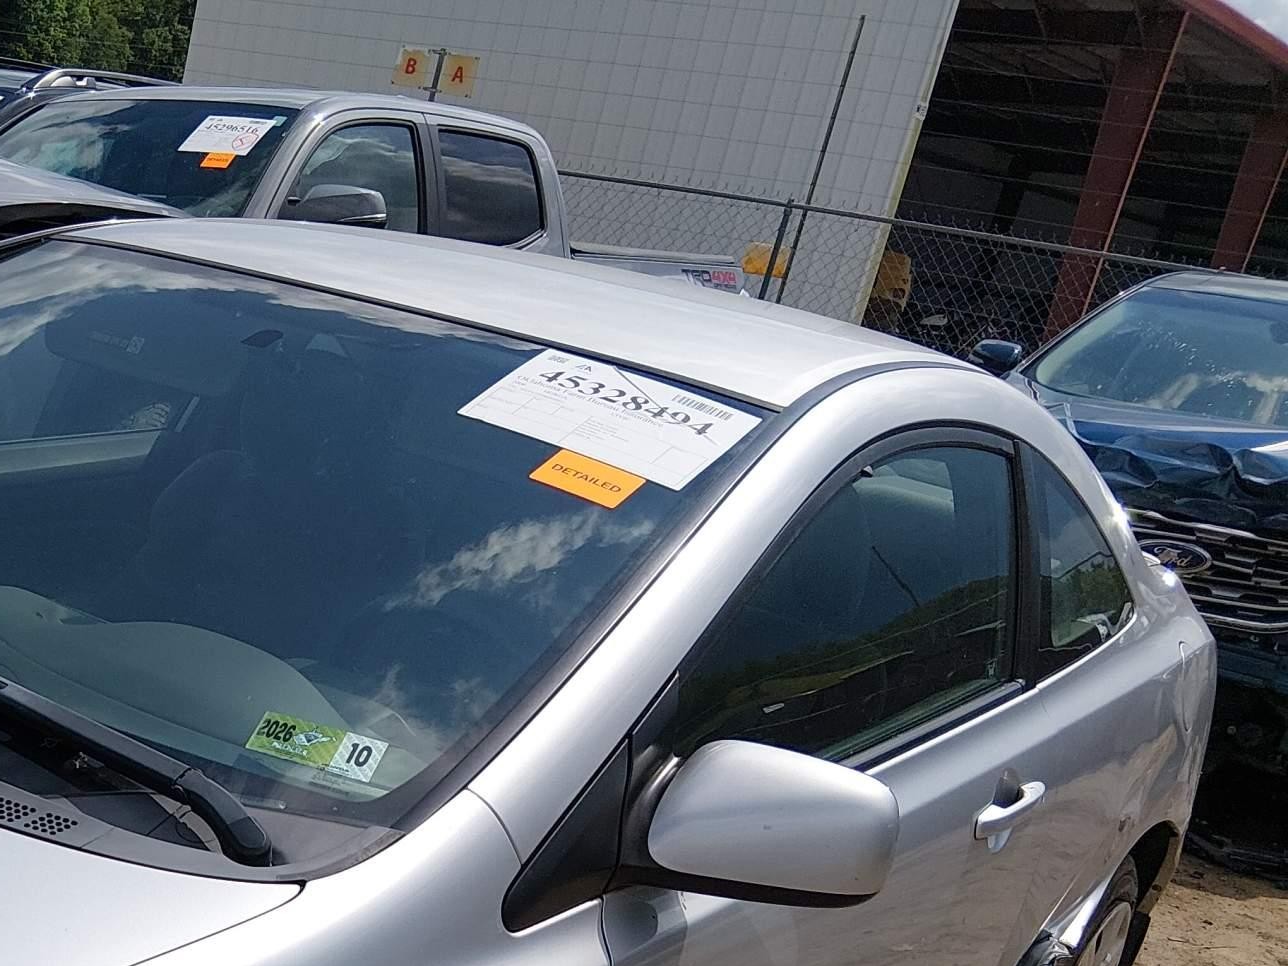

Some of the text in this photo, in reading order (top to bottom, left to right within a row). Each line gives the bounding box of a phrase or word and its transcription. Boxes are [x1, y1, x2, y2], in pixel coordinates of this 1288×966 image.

[404, 57, 417, 74] B
[451, 65, 464, 83] A
[539, 371, 715, 435] 45328494
[551, 462, 622, 495] DETAILED
[257, 718, 296, 742] 2026
[345, 742, 373, 767] 10
